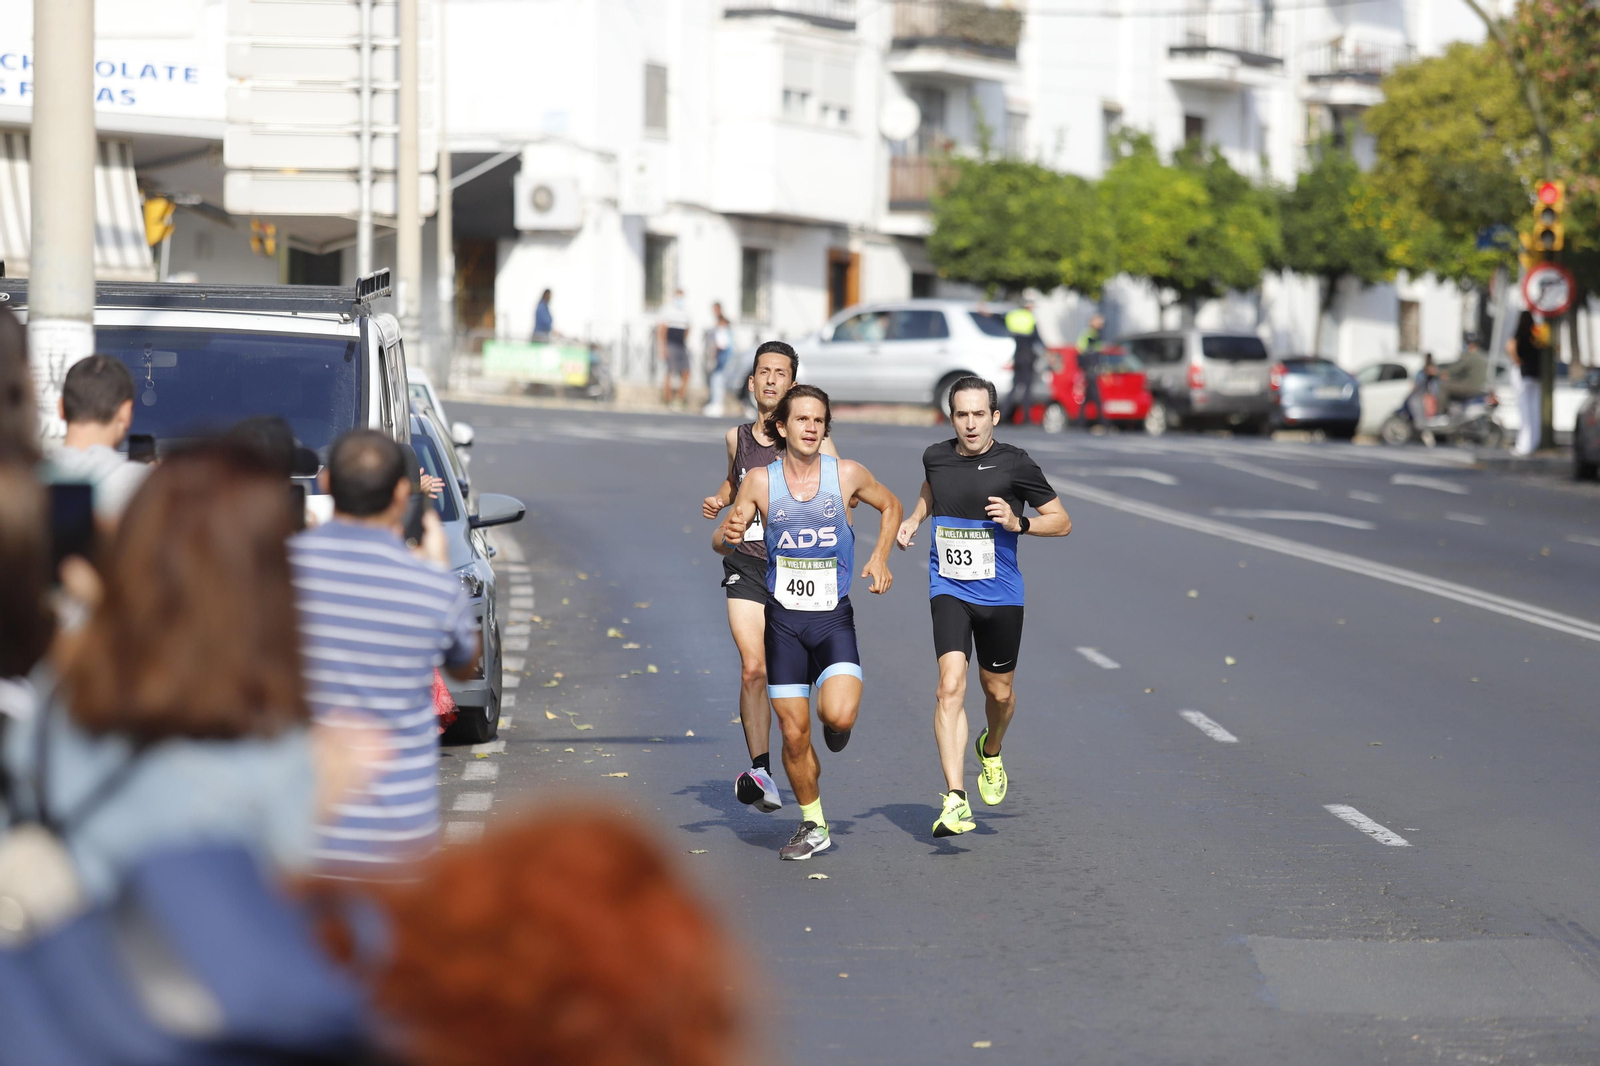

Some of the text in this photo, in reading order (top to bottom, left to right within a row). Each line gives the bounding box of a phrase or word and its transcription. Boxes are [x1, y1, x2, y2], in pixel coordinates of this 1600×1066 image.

[0, 53, 198, 84] CHOLATE
[777, 526, 838, 549] ADS
[945, 530, 963, 538] VUELTA
[970, 531, 990, 539] HUELVA
[787, 561, 807, 569] VUELTA
[813, 561, 833, 569] HUELVA
[946, 548, 973, 566] 633
[786, 578, 815, 597] 490
